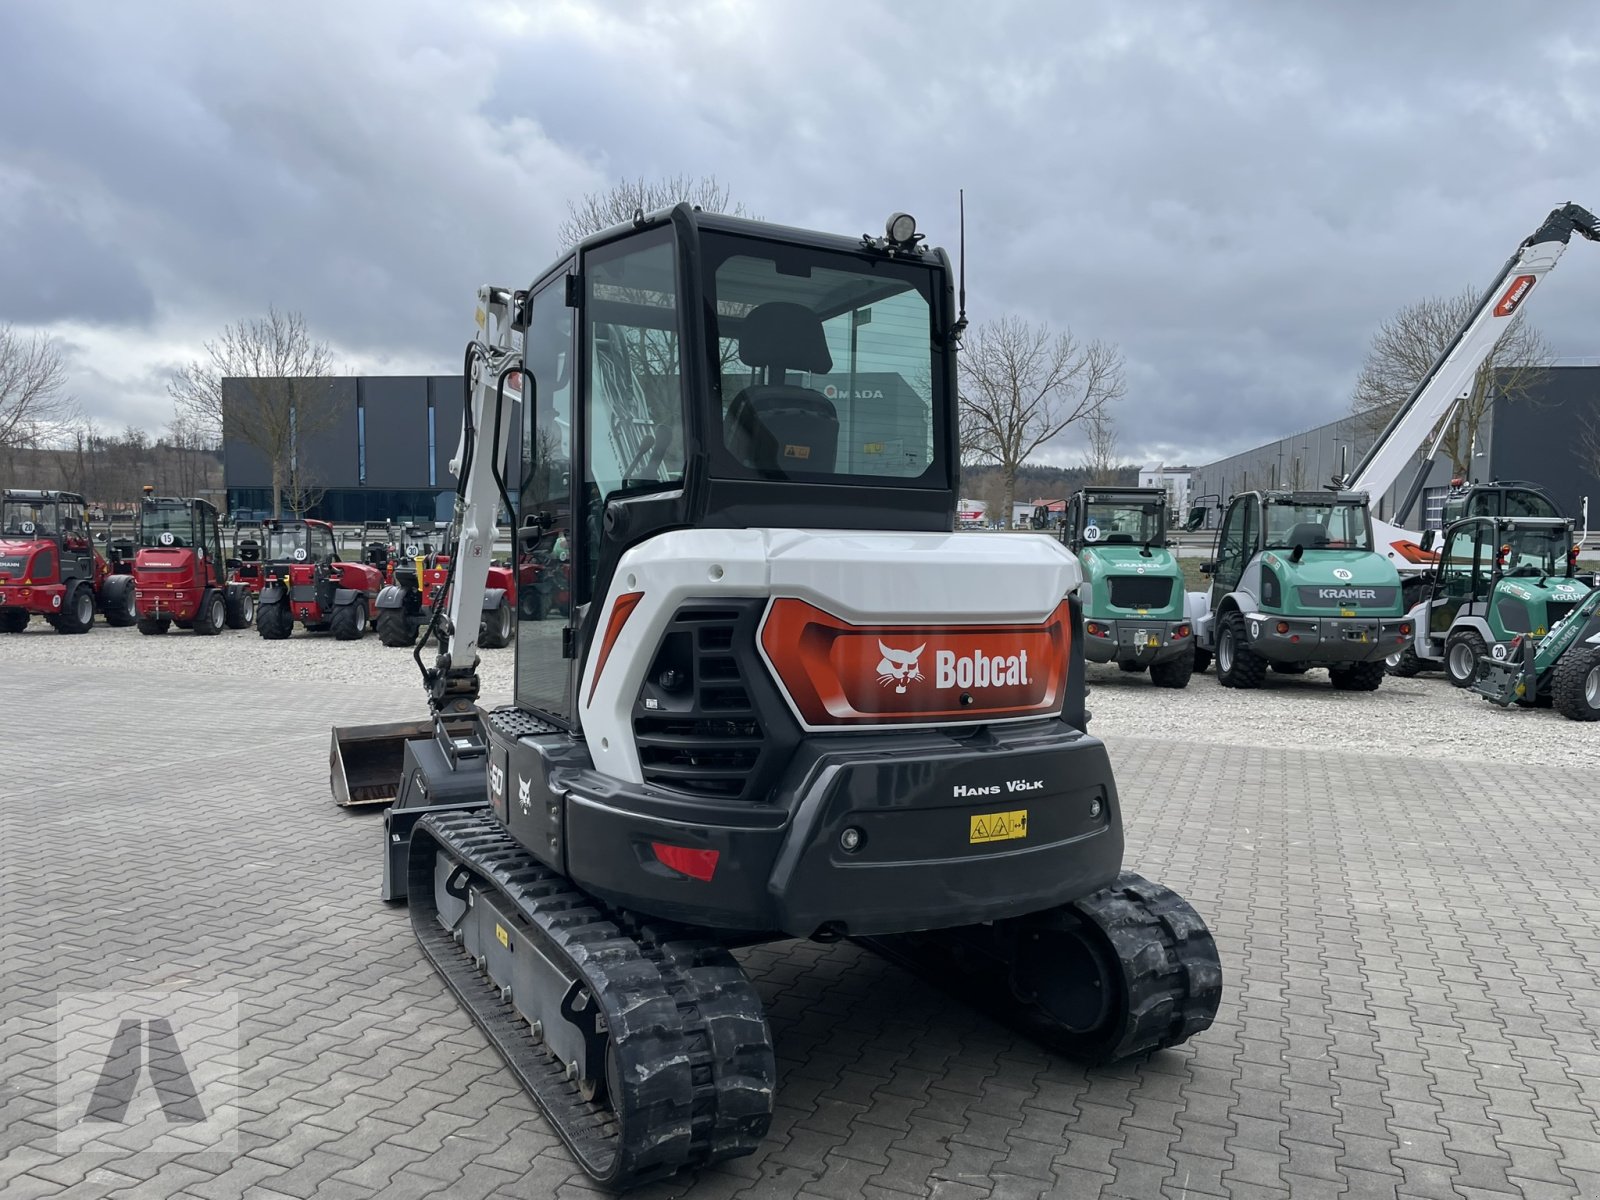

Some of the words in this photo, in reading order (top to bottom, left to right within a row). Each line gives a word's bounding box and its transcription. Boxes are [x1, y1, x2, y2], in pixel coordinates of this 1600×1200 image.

[1087, 528, 1097, 539] 20
[1336, 570, 1349, 578] 20
[1319, 588, 1376, 599] KRAMER
[1548, 625, 1579, 657] KRAMER
[1495, 646, 1504, 658] 20
[936, 649, 1027, 689] Bobcat
[953, 785, 1000, 797] HANS
[1006, 780, 1043, 793] VÖLK
